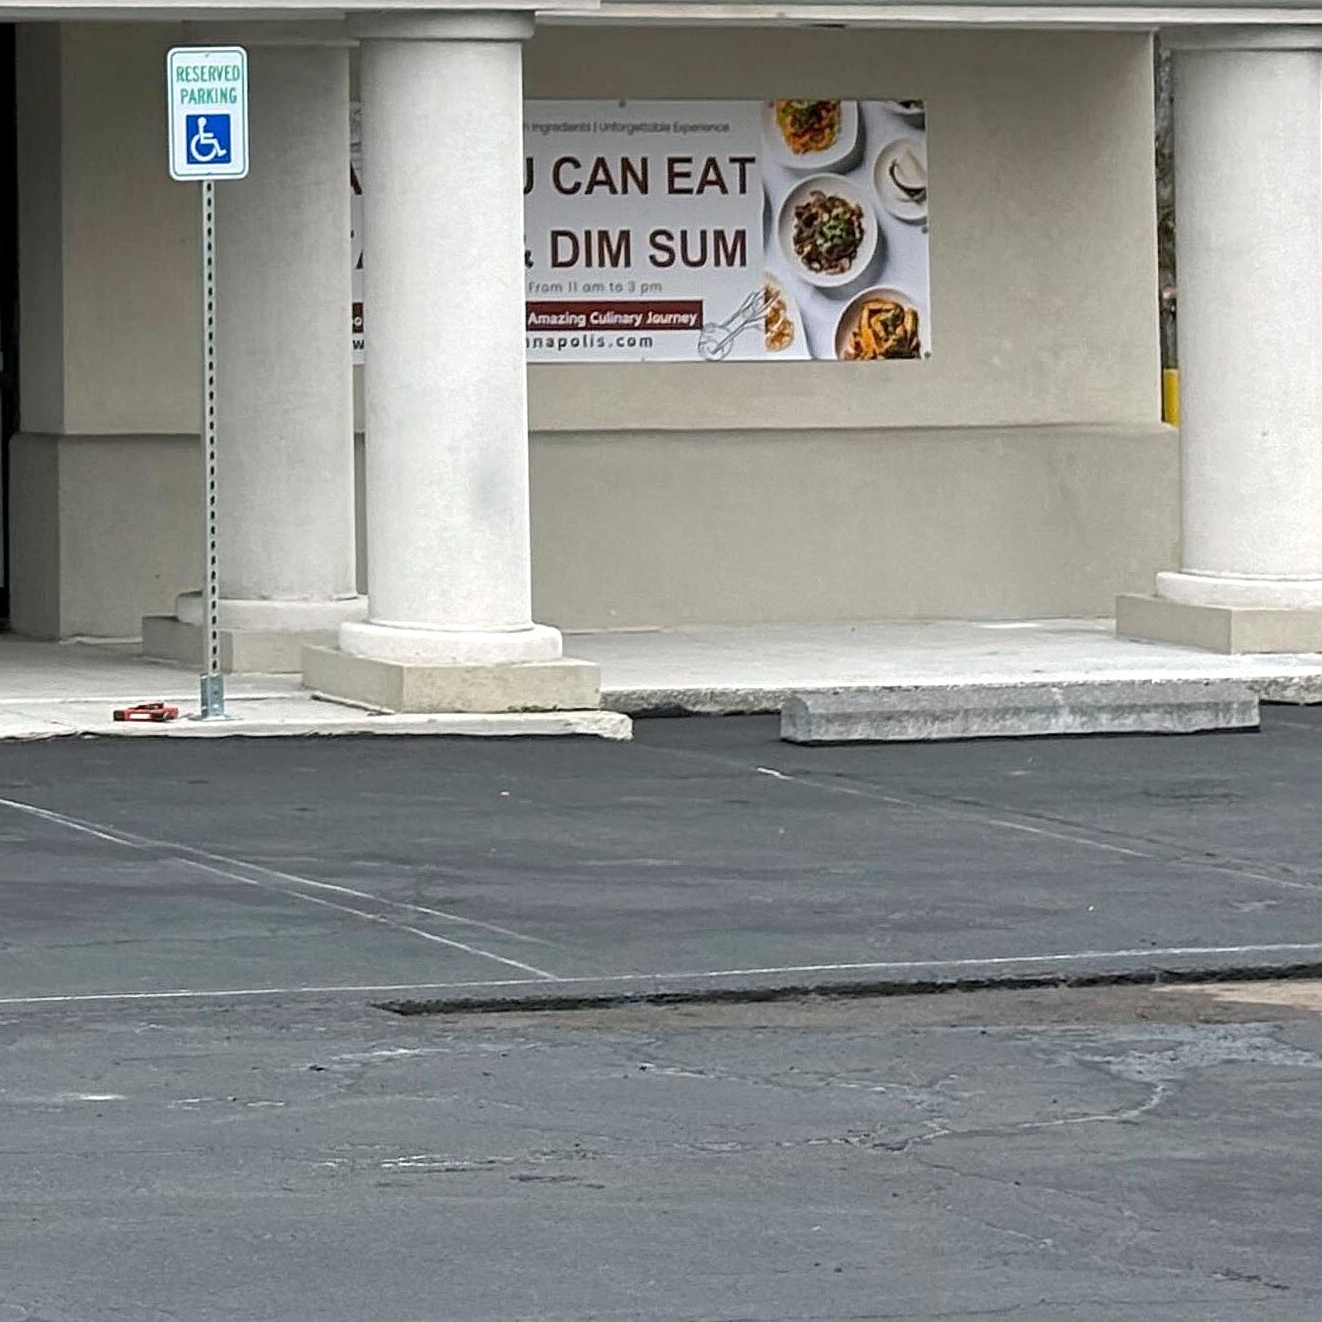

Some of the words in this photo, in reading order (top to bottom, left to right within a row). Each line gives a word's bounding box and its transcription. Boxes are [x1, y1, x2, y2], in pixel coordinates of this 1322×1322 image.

[175, 64, 241, 82] RESERVED
[180, 86, 238, 105] PARKING
[598, 121, 672, 136] Unforgettable
[673, 121, 731, 135] Experience
[551, 156, 649, 195] CAN
[667, 156, 757, 195] EAT
[550, 229, 632, 269] DIM
[648, 229, 748, 269] SUM
[528, 281, 563, 293] From
[582, 282, 604, 293] am
[608, 281, 623, 293] to
[627, 281, 636, 293] 3
[640, 282, 663, 296] pm
[528, 312, 587, 327] Amazing
[589, 310, 643, 326] Culinary
[646, 310, 698, 326] Journey
